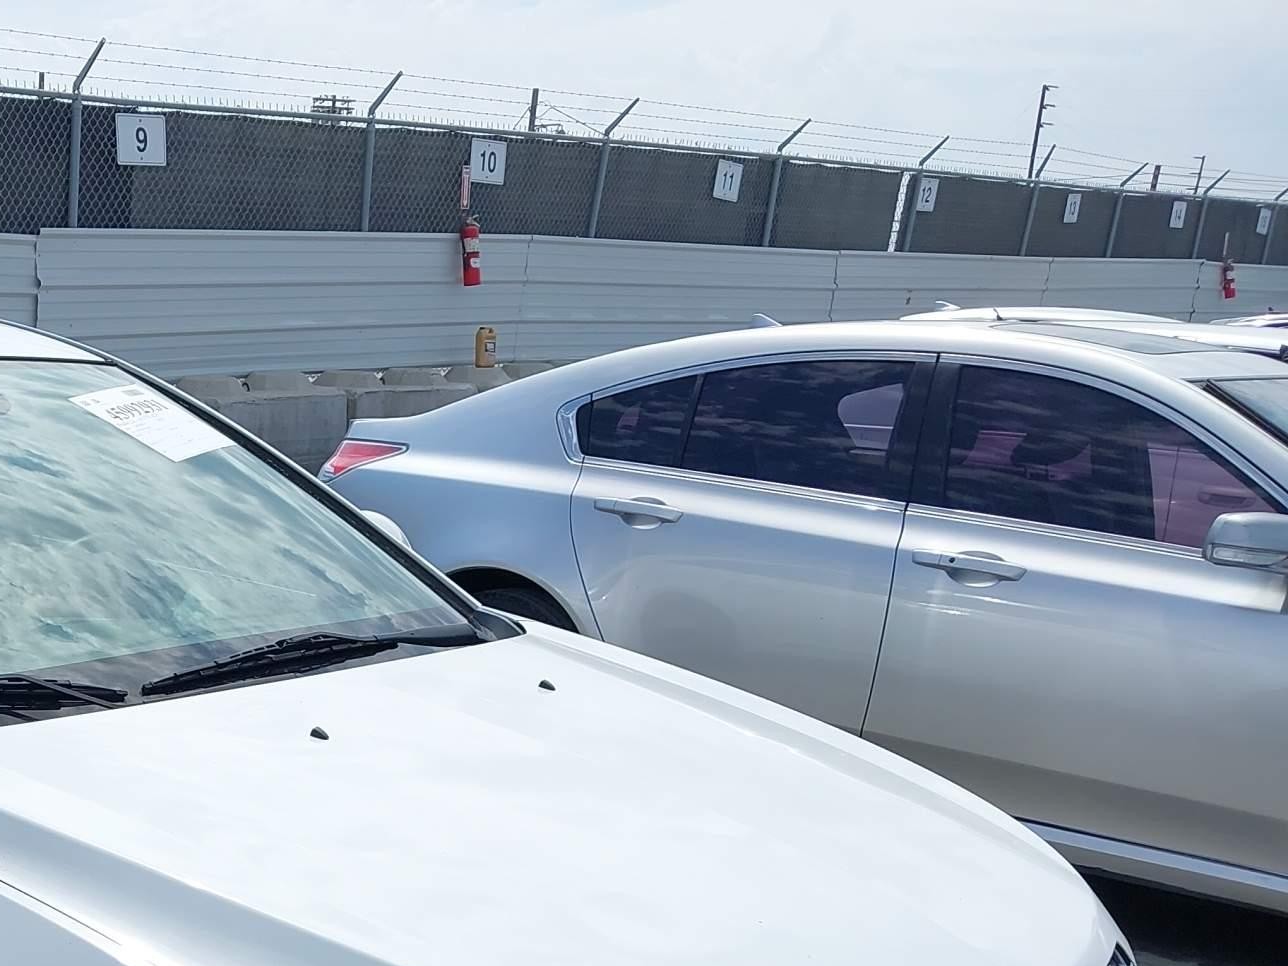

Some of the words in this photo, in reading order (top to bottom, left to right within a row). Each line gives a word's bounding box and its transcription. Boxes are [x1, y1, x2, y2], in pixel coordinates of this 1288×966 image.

[135, 126, 148, 153] 9
[480, 150, 497, 174] 10
[721, 171, 734, 191] 11
[920, 187, 933, 204] 12
